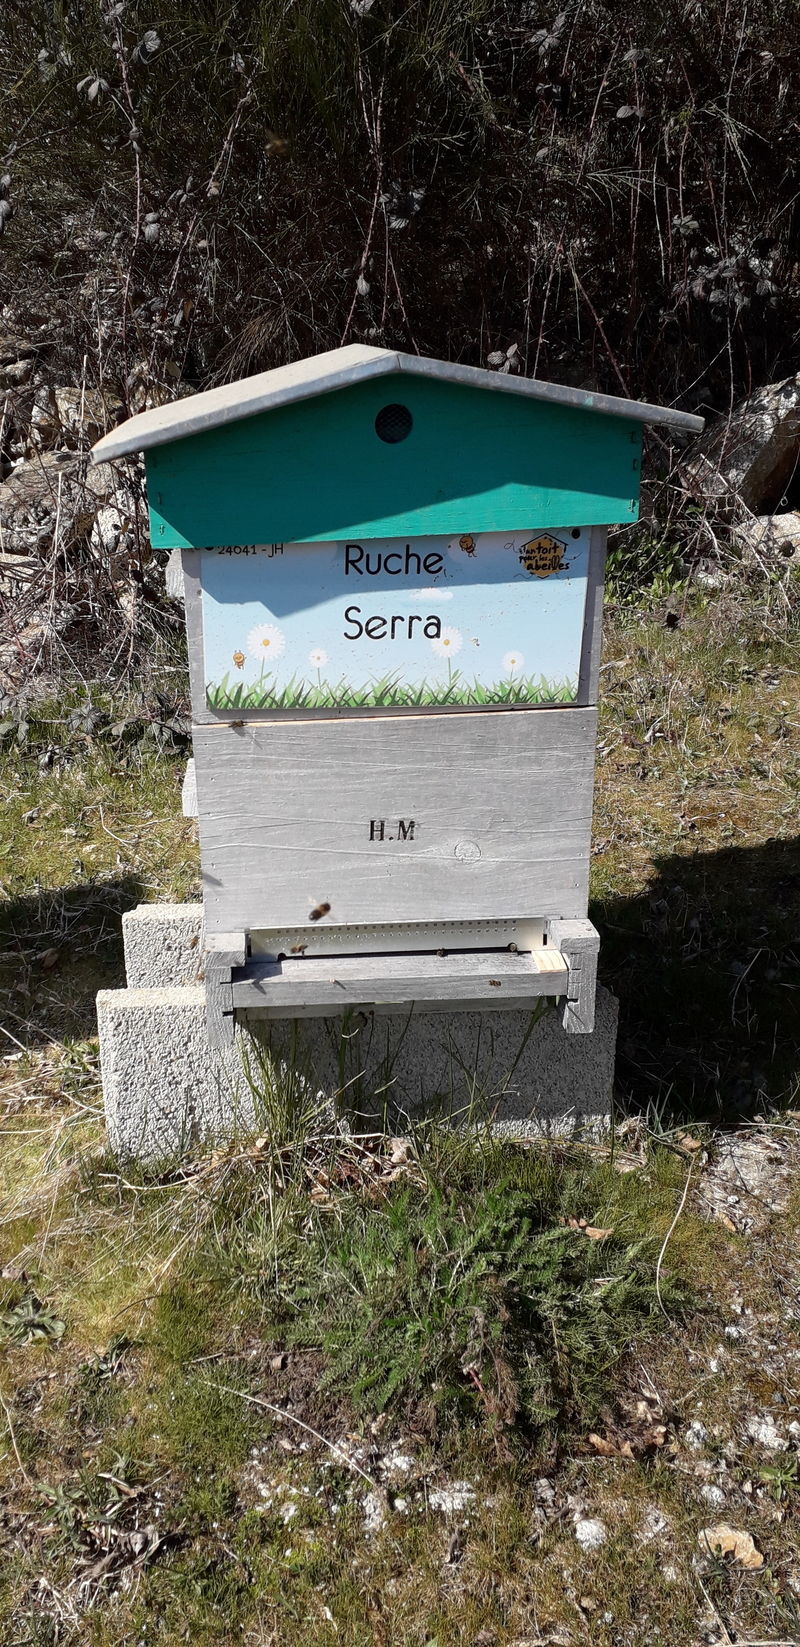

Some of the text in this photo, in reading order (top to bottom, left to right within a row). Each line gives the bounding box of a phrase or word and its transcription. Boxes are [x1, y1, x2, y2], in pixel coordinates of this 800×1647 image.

[268, 543, 283, 558] JH
[536, 542, 559, 554] toit
[345, 544, 443, 575] Ruche
[526, 555, 570, 571] abeilles
[344, 606, 441, 640] Serra
